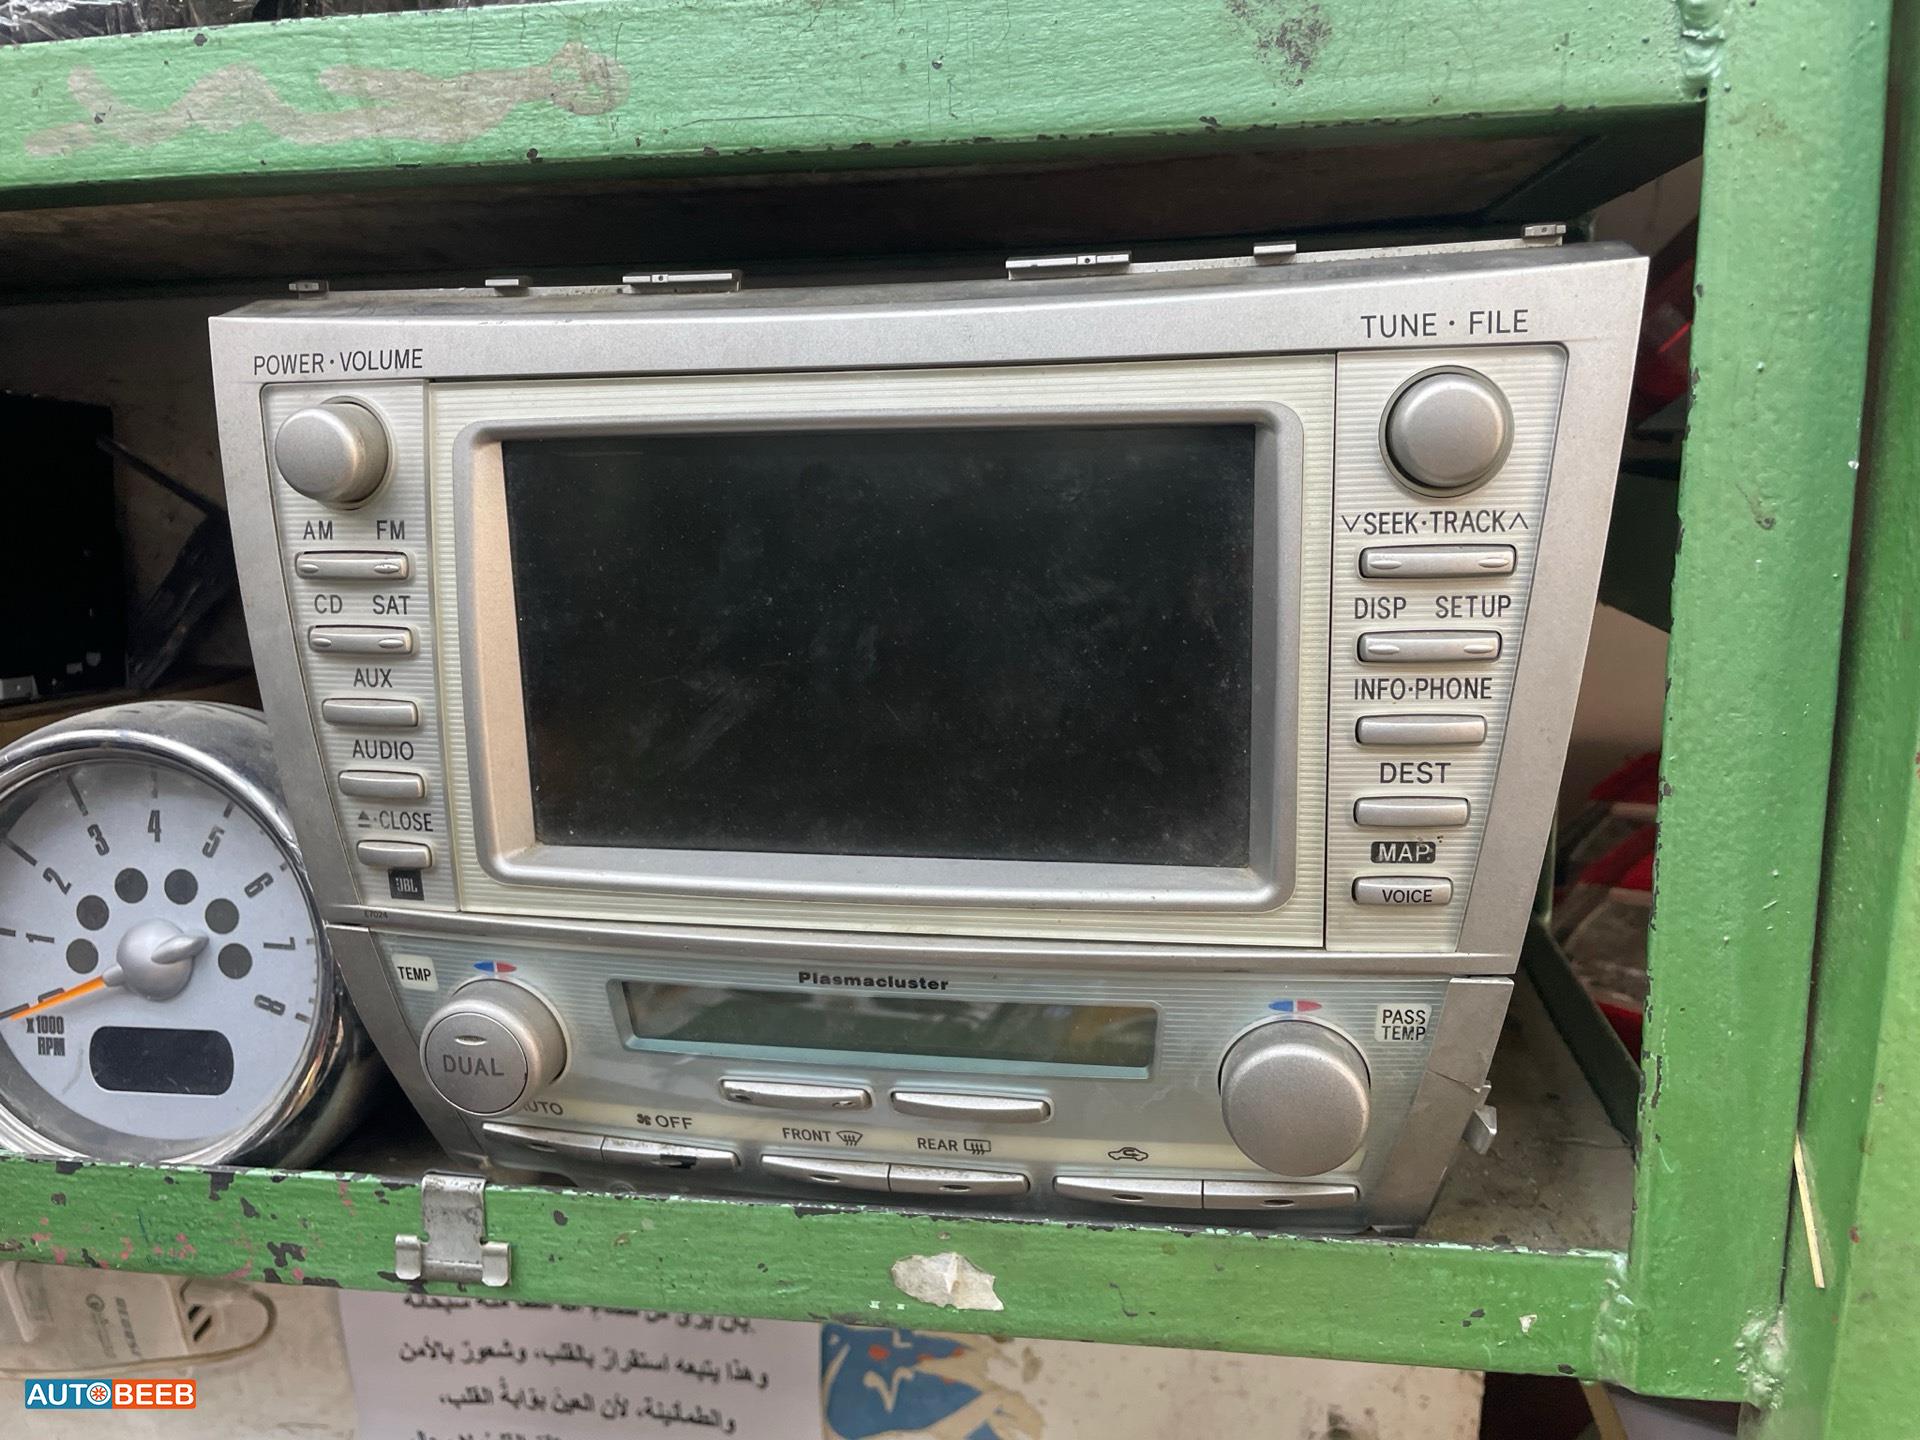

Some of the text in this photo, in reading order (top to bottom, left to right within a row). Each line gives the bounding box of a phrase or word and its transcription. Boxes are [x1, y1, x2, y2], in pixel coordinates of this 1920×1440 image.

[1360, 309, 1528, 338] TUNE FILE
[254, 349, 424, 375] POWER VOLUME
[303, 520, 405, 540] AM FM
[314, 595, 411, 615] CD SAT
[1354, 595, 1511, 620] DISP SETUP
[353, 668, 393, 688] AUX
[352, 740, 414, 760] AUDIO
[1380, 762, 1451, 784] DEST
[147, 809, 162, 843] 4
[379, 810, 434, 832] CLOSE
[87, 823, 110, 856] 3
[202, 825, 225, 858] 5
[1377, 842, 1430, 862] MAP
[43, 867, 72, 895] 2
[244, 872, 274, 898] 6
[395, 877, 418, 893] JBL
[1382, 889, 1433, 903] VOICE
[26, 932, 55, 944] 1
[263, 936, 296, 951] 7
[397, 966, 431, 982] TEMP
[799, 972, 949, 991] Plasmacluster
[254, 994, 286, 1016] 8
[1382, 1009, 1426, 1025] PASS
[1382, 1026, 1426, 1041] TEMP
[38, 1036, 65, 1056] RPM
[443, 1054, 505, 1077] DUAL
[655, 1114, 693, 1130] OFF
[782, 1127, 831, 1143] FRONT
[917, 1137, 958, 1152] REAR
